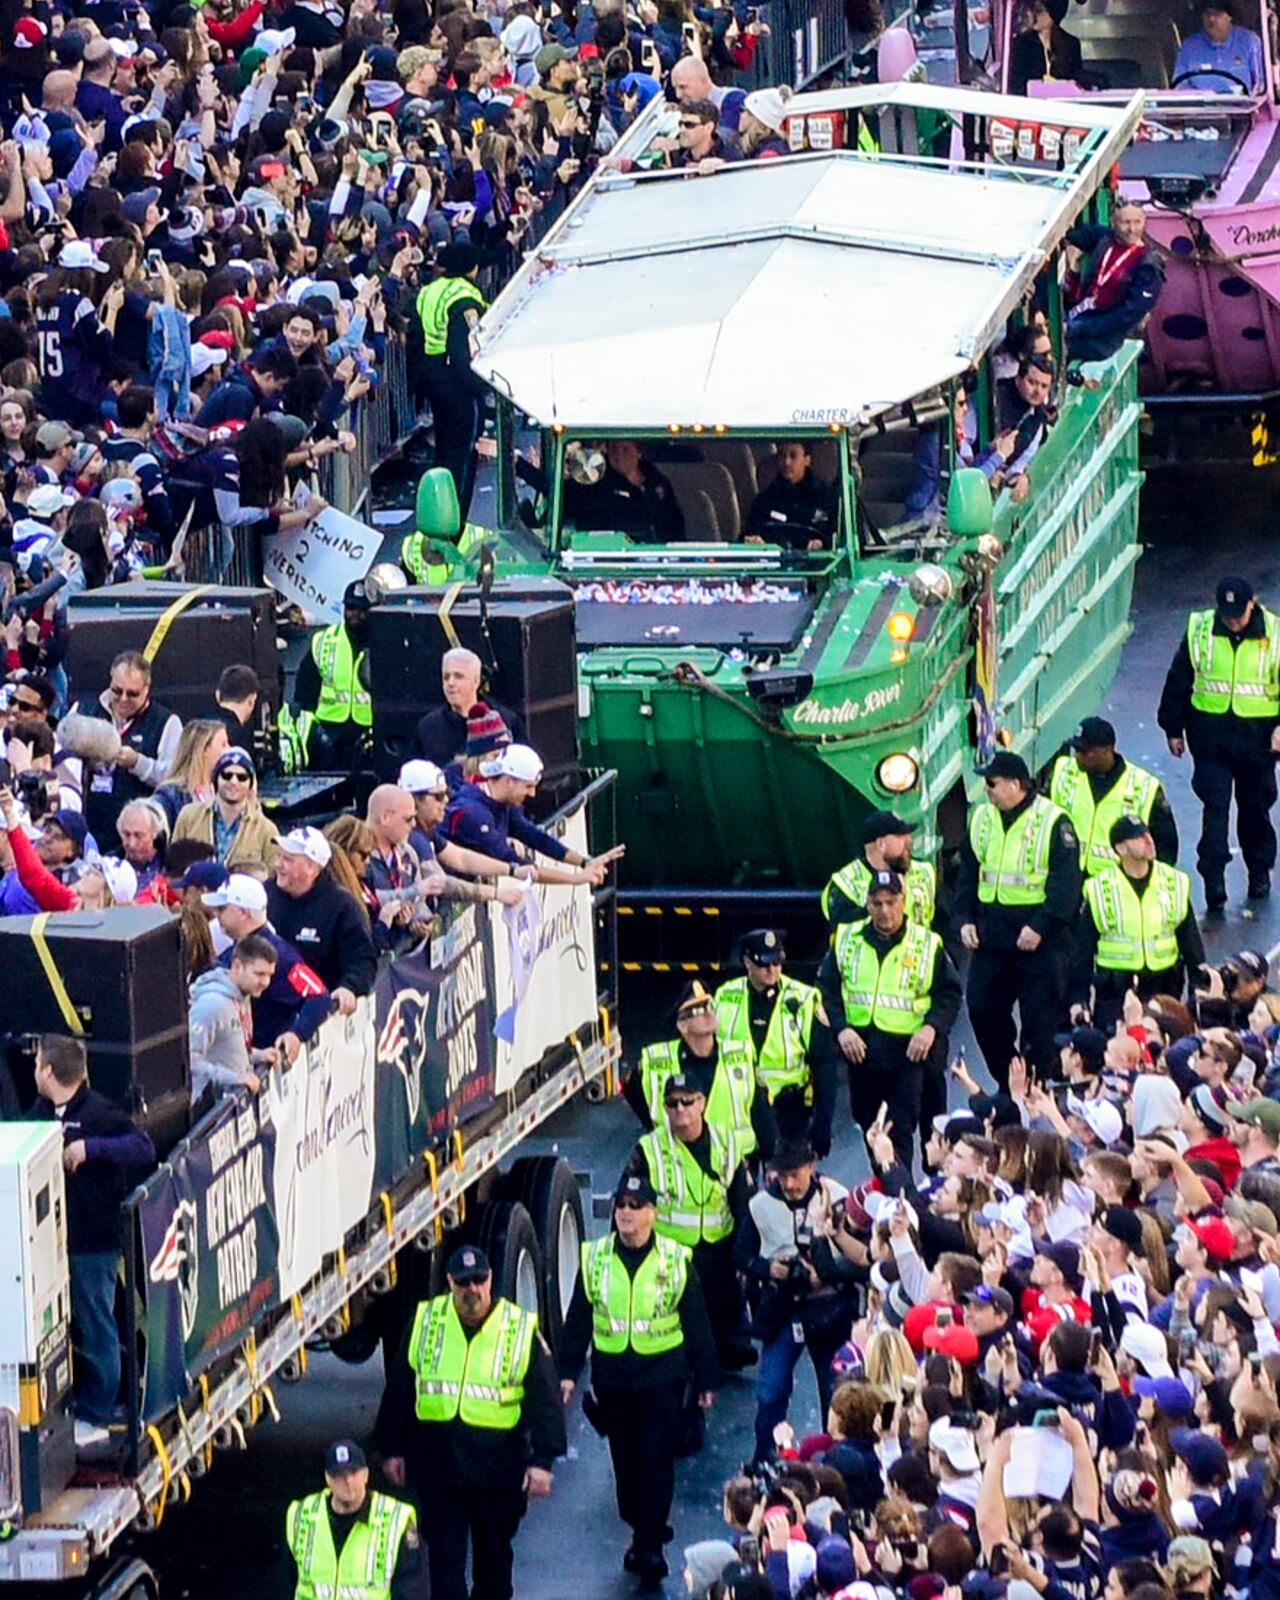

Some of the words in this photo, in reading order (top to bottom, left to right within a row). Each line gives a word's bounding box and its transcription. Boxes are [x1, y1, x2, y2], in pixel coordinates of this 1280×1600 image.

[38, 330, 63, 378] 15
[792, 407, 848, 421] CHARTER
[295, 539, 309, 563] 2
